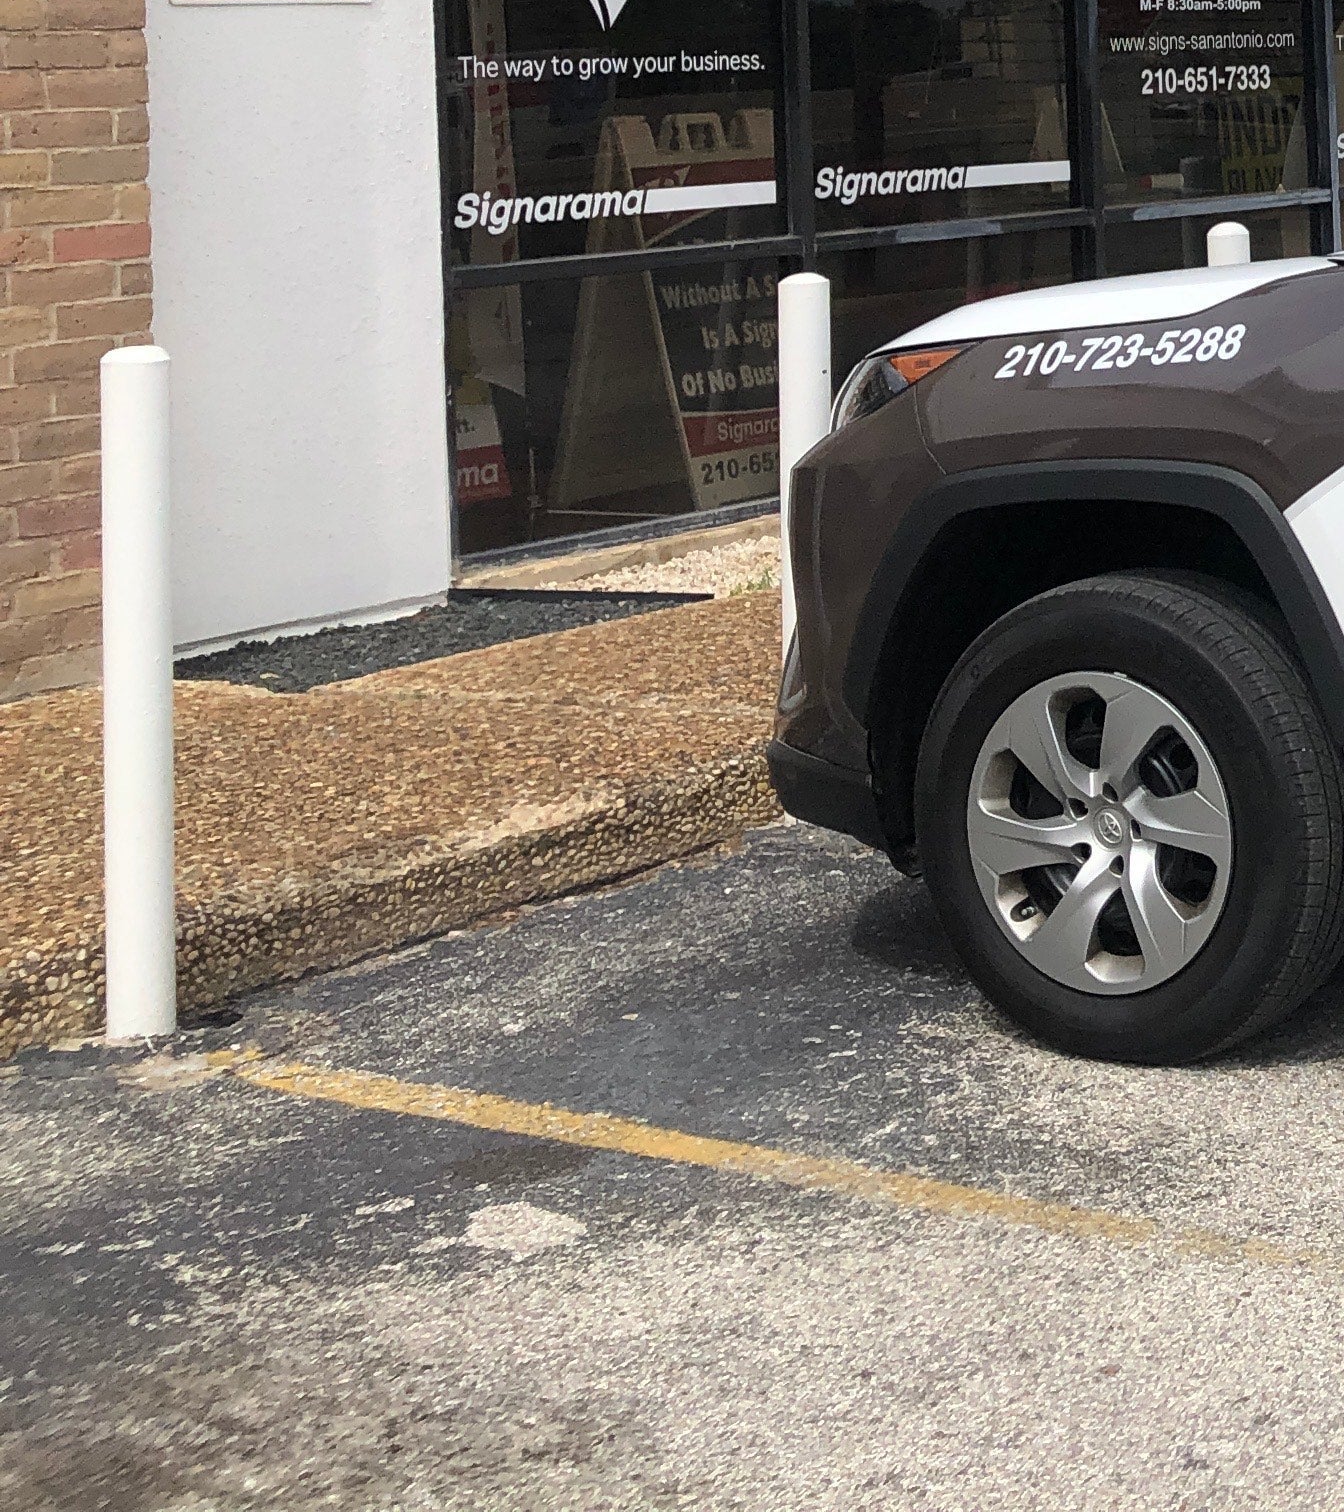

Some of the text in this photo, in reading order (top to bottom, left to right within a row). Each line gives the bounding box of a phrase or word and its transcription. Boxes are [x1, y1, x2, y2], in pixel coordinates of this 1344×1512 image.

[1140, 0, 1164, 11] M-F
[1110, 29, 1295, 55] www.signs-sanantonio.com
[458, 50, 766, 81] The way to grow your business.
[1141, 64, 1271, 95] 210-651-7333
[814, 161, 967, 205] Signarama
[454, 190, 650, 235] Signarama
[723, 323, 740, 347] A
[994, 323, 1246, 379] 210-723-5288
[709, 369, 735, 396] No
[701, 453, 779, 487] 210-65
